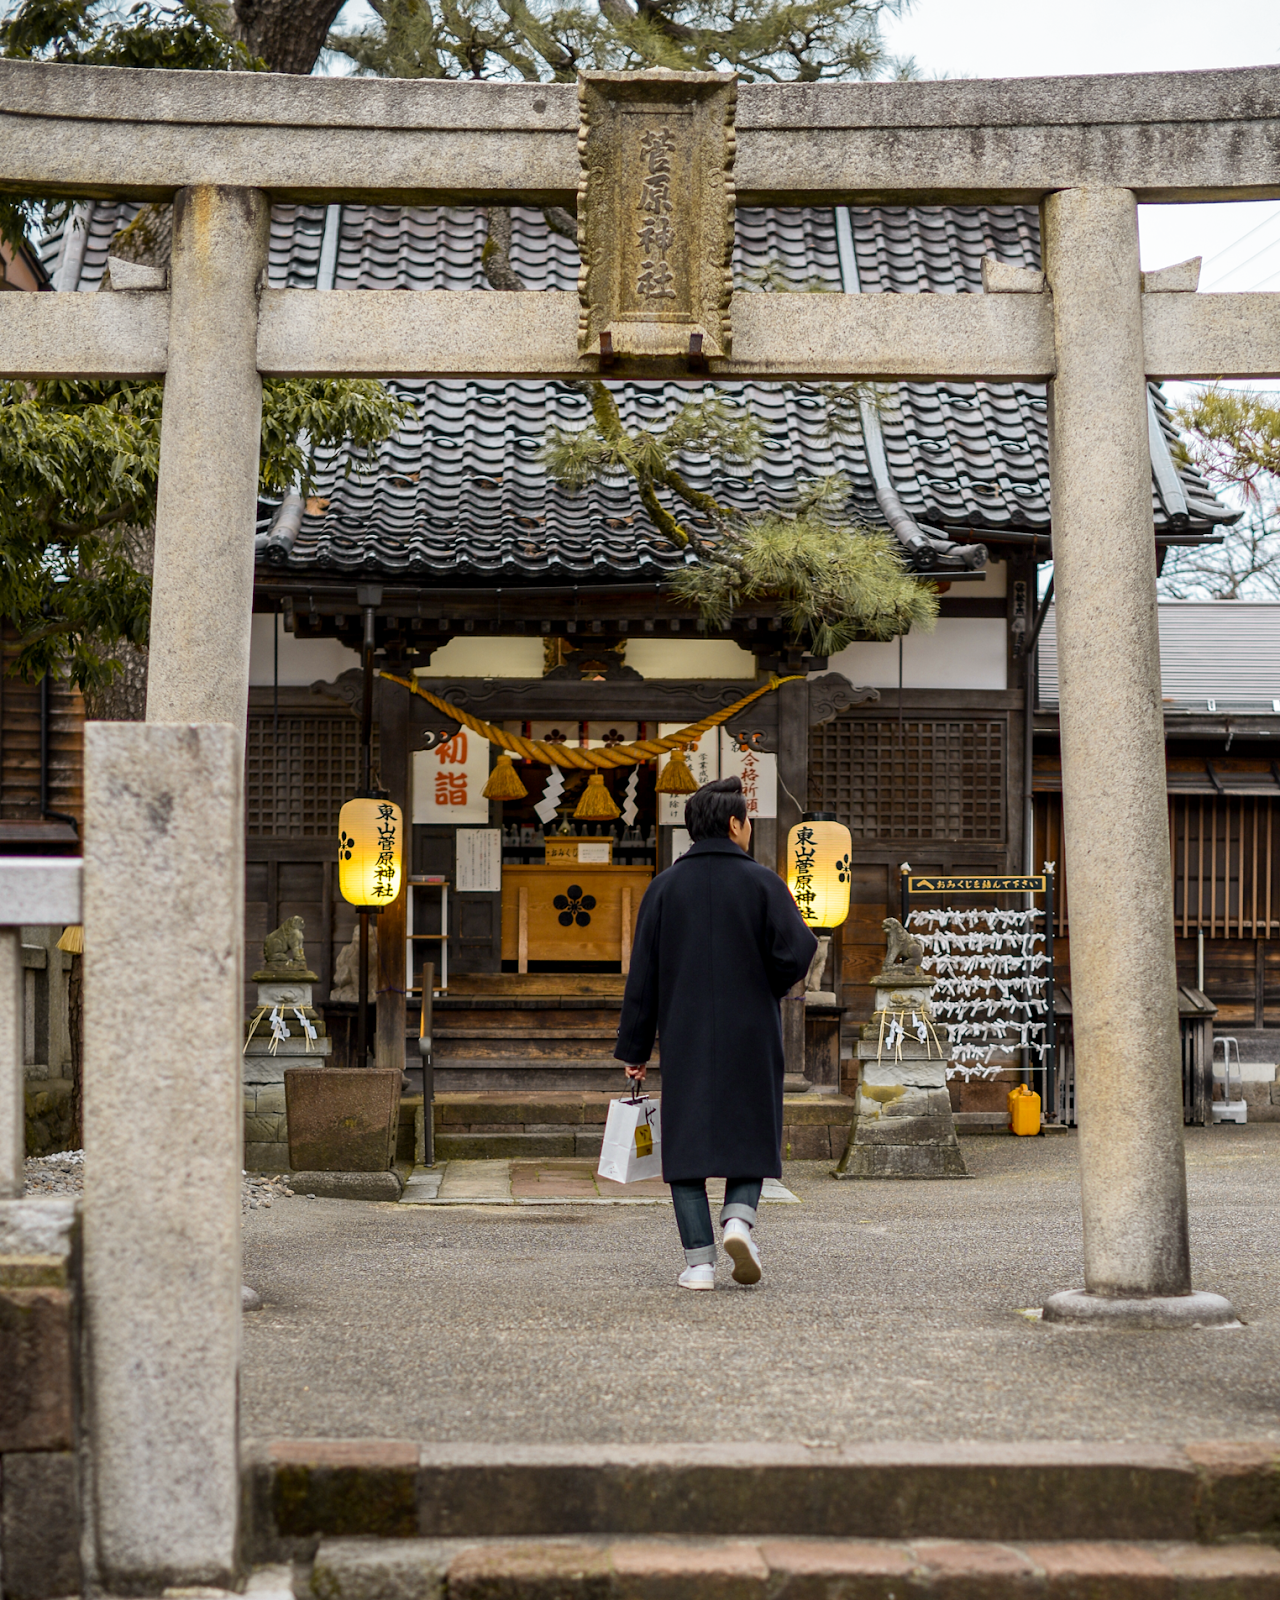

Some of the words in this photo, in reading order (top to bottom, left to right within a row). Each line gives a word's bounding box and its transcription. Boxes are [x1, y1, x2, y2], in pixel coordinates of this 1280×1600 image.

[636, 127, 676, 299] 菅原神社
[434, 731, 468, 806] 初詣
[371, 803, 398, 898] 東山菅原神社
[793, 826, 819, 920] 東山菅原神社
